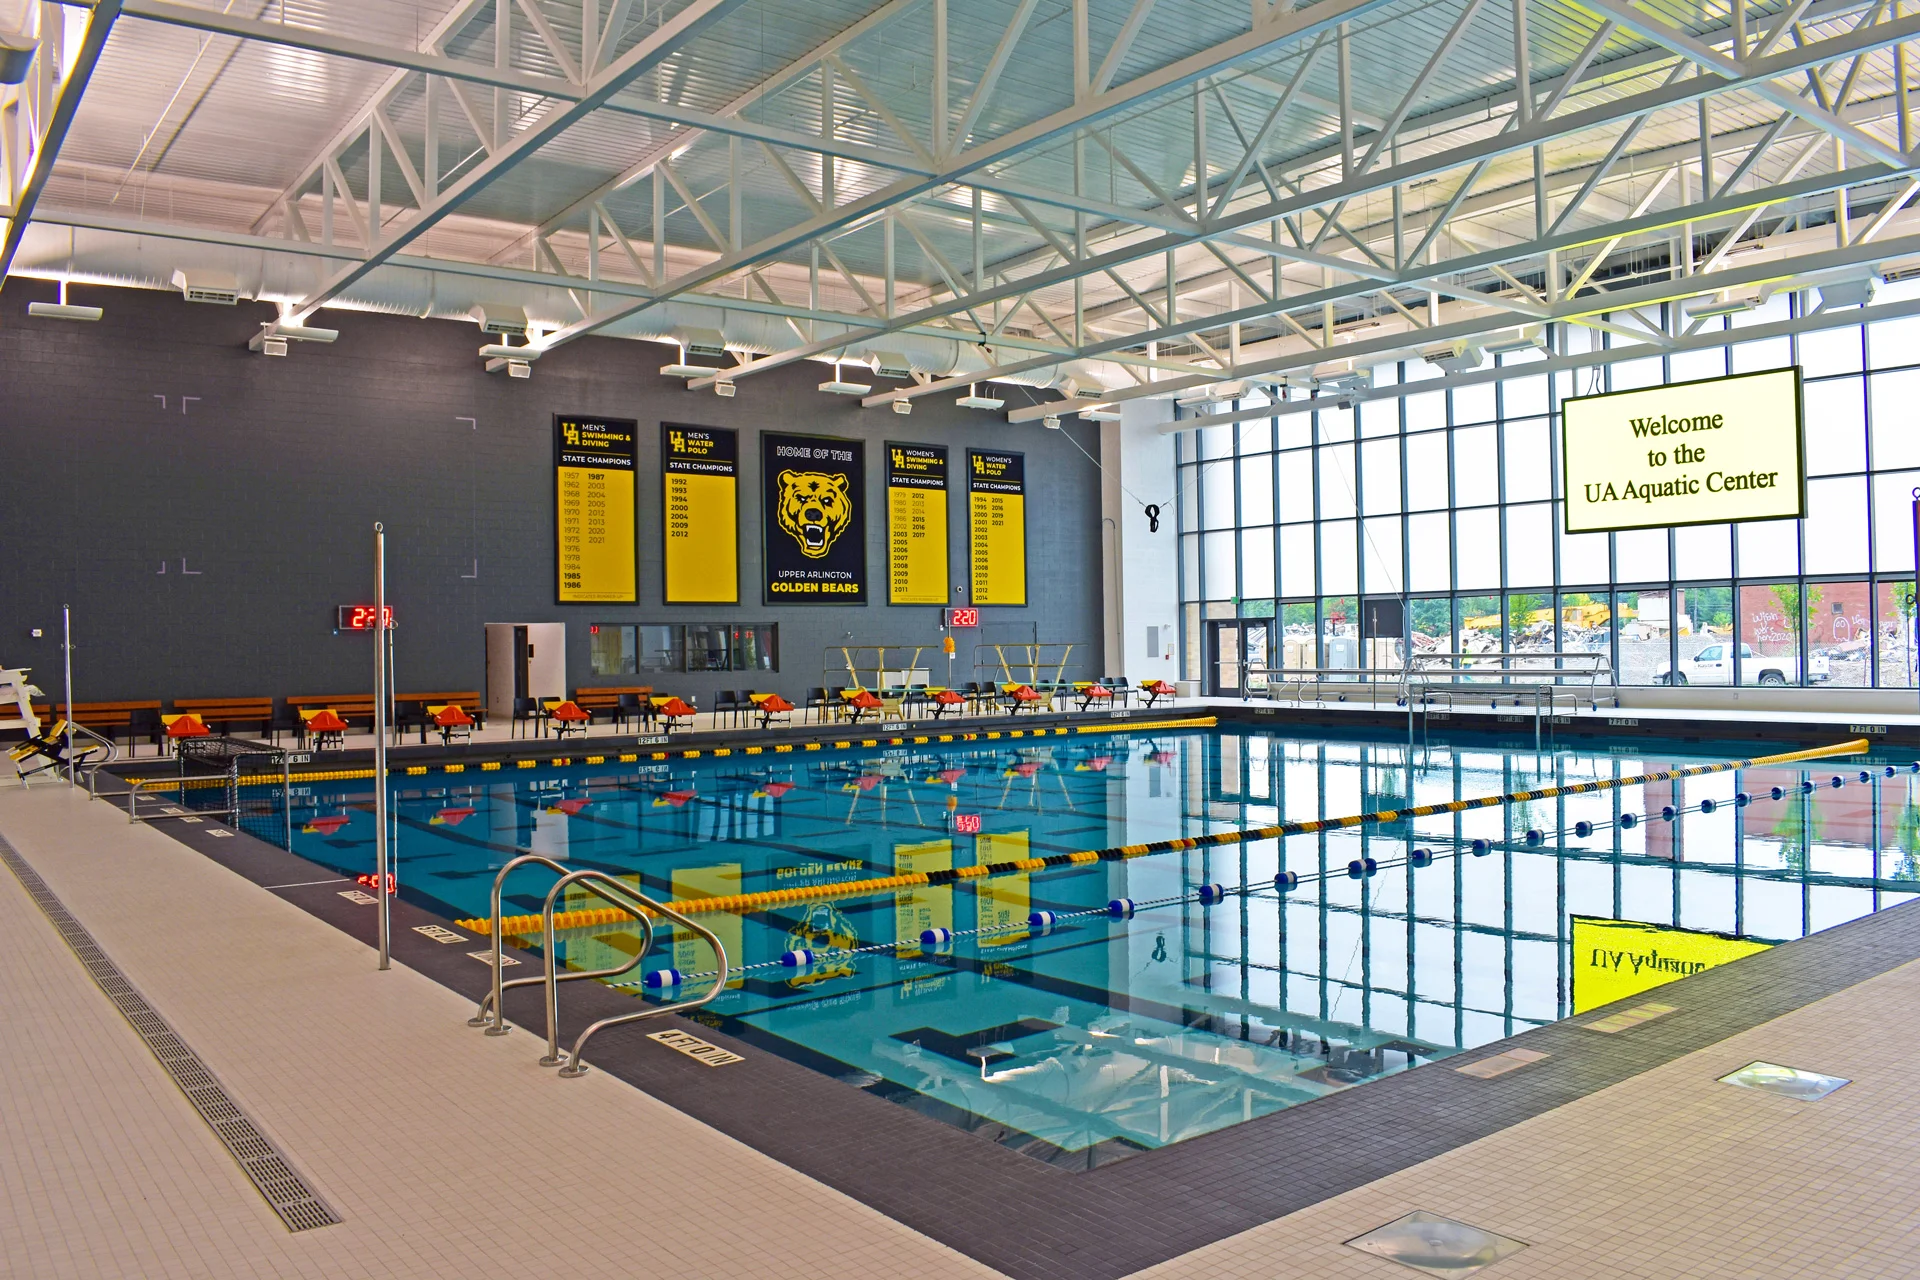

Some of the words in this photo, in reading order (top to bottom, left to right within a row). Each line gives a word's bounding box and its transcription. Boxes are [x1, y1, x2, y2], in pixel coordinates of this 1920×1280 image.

[1629, 413, 1723, 438] Welcome
[582, 432, 624, 441] SWIMMING
[777, 446, 810, 458] HOME
[813, 449, 828, 458] OF
[831, 450, 852, 461] THE
[1648, 450, 1666, 466] to
[1674, 444, 1705, 464] the
[587, 457, 631, 465] CHAMPIONS
[1584, 482, 1619, 502] UA
[1623, 474, 1700, 503] Aquatic
[1706, 471, 1778, 493] Center
[778, 570, 806, 578] UPPER
[807, 571, 852, 579] ARLINGTON
[771, 582, 819, 593] GOLDEN
[822, 583, 858, 593] BEARS
[954, 610, 976, 624] 2:20
[668, 1037, 702, 1047] FT
[704, 1053, 737, 1064] IN
